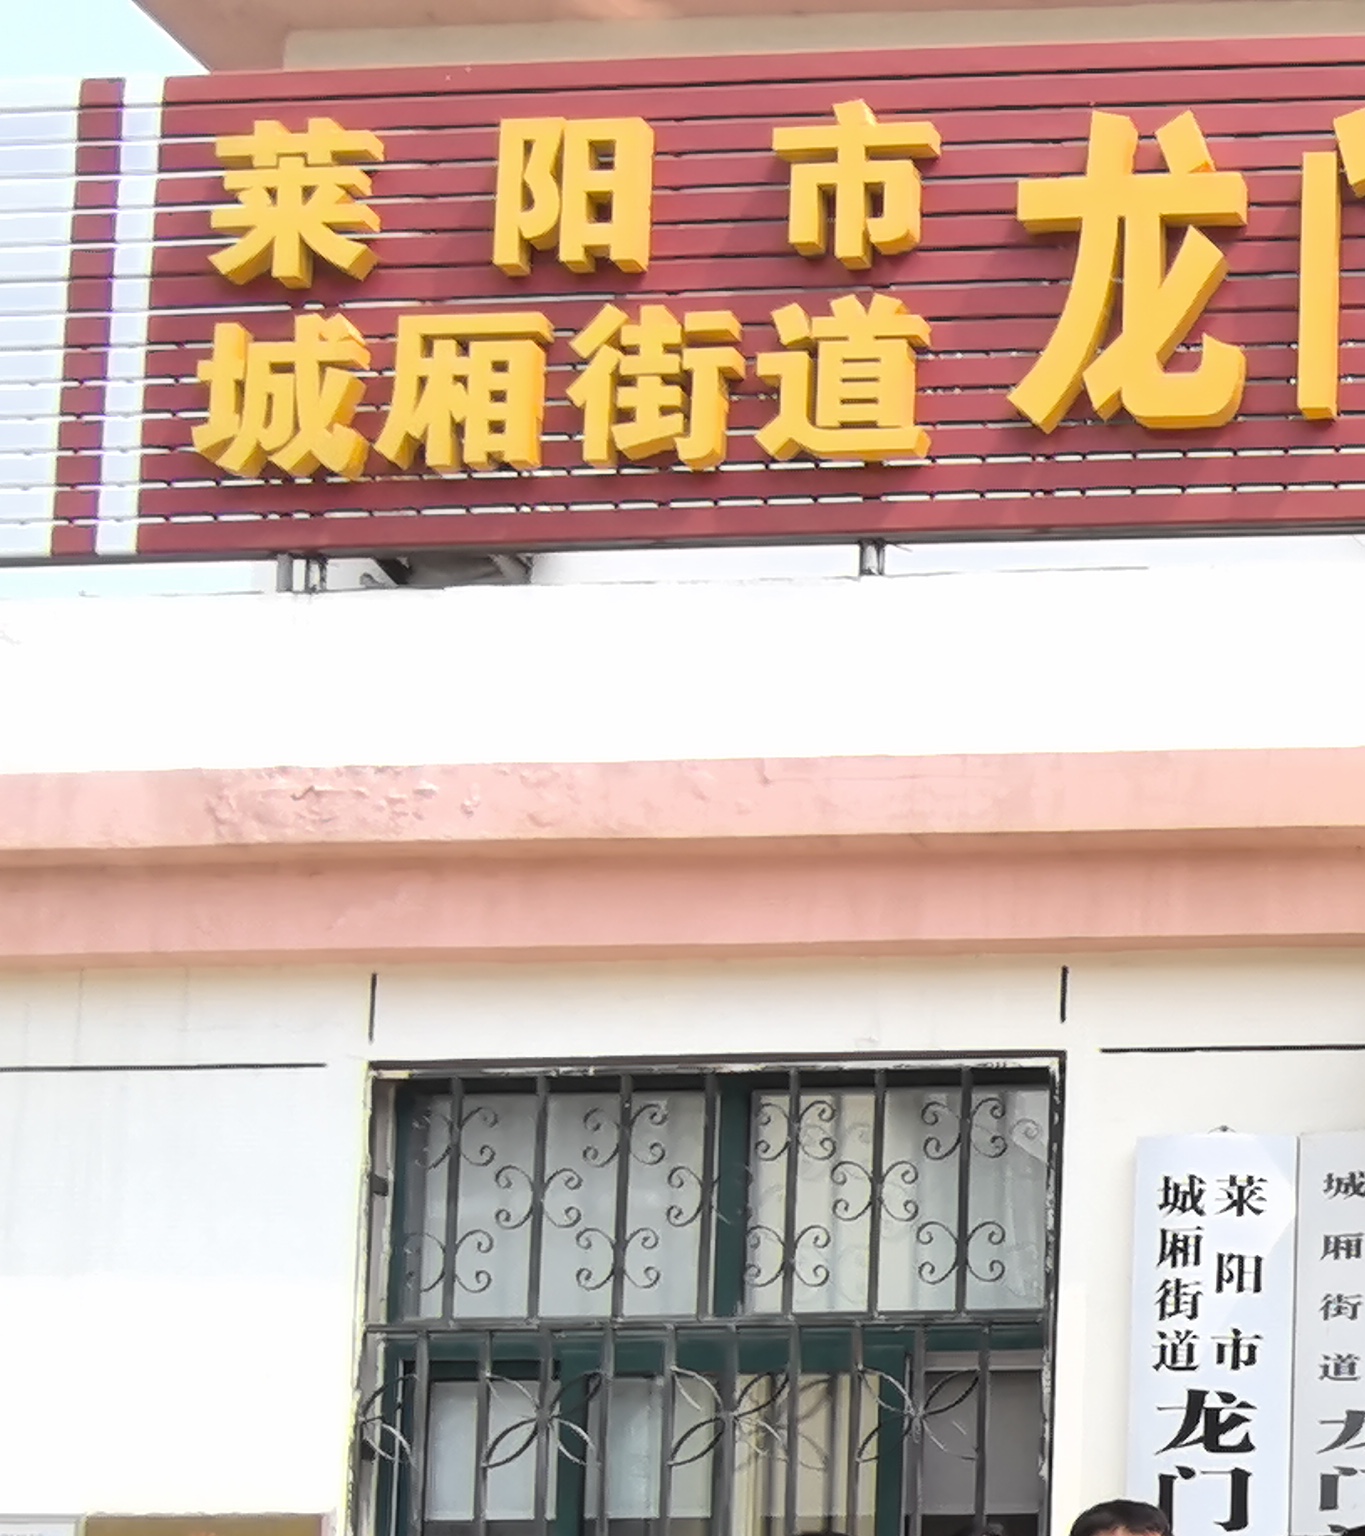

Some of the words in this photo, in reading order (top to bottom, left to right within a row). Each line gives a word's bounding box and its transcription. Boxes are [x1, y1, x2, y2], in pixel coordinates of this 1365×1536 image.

[207, 97, 943, 291] 莱阳市
[191, 292, 933, 483] 城厢街道
[1151, 1173, 1208, 1373] 城厢街道
[1209, 1173, 1269, 1372] 莱阳市
